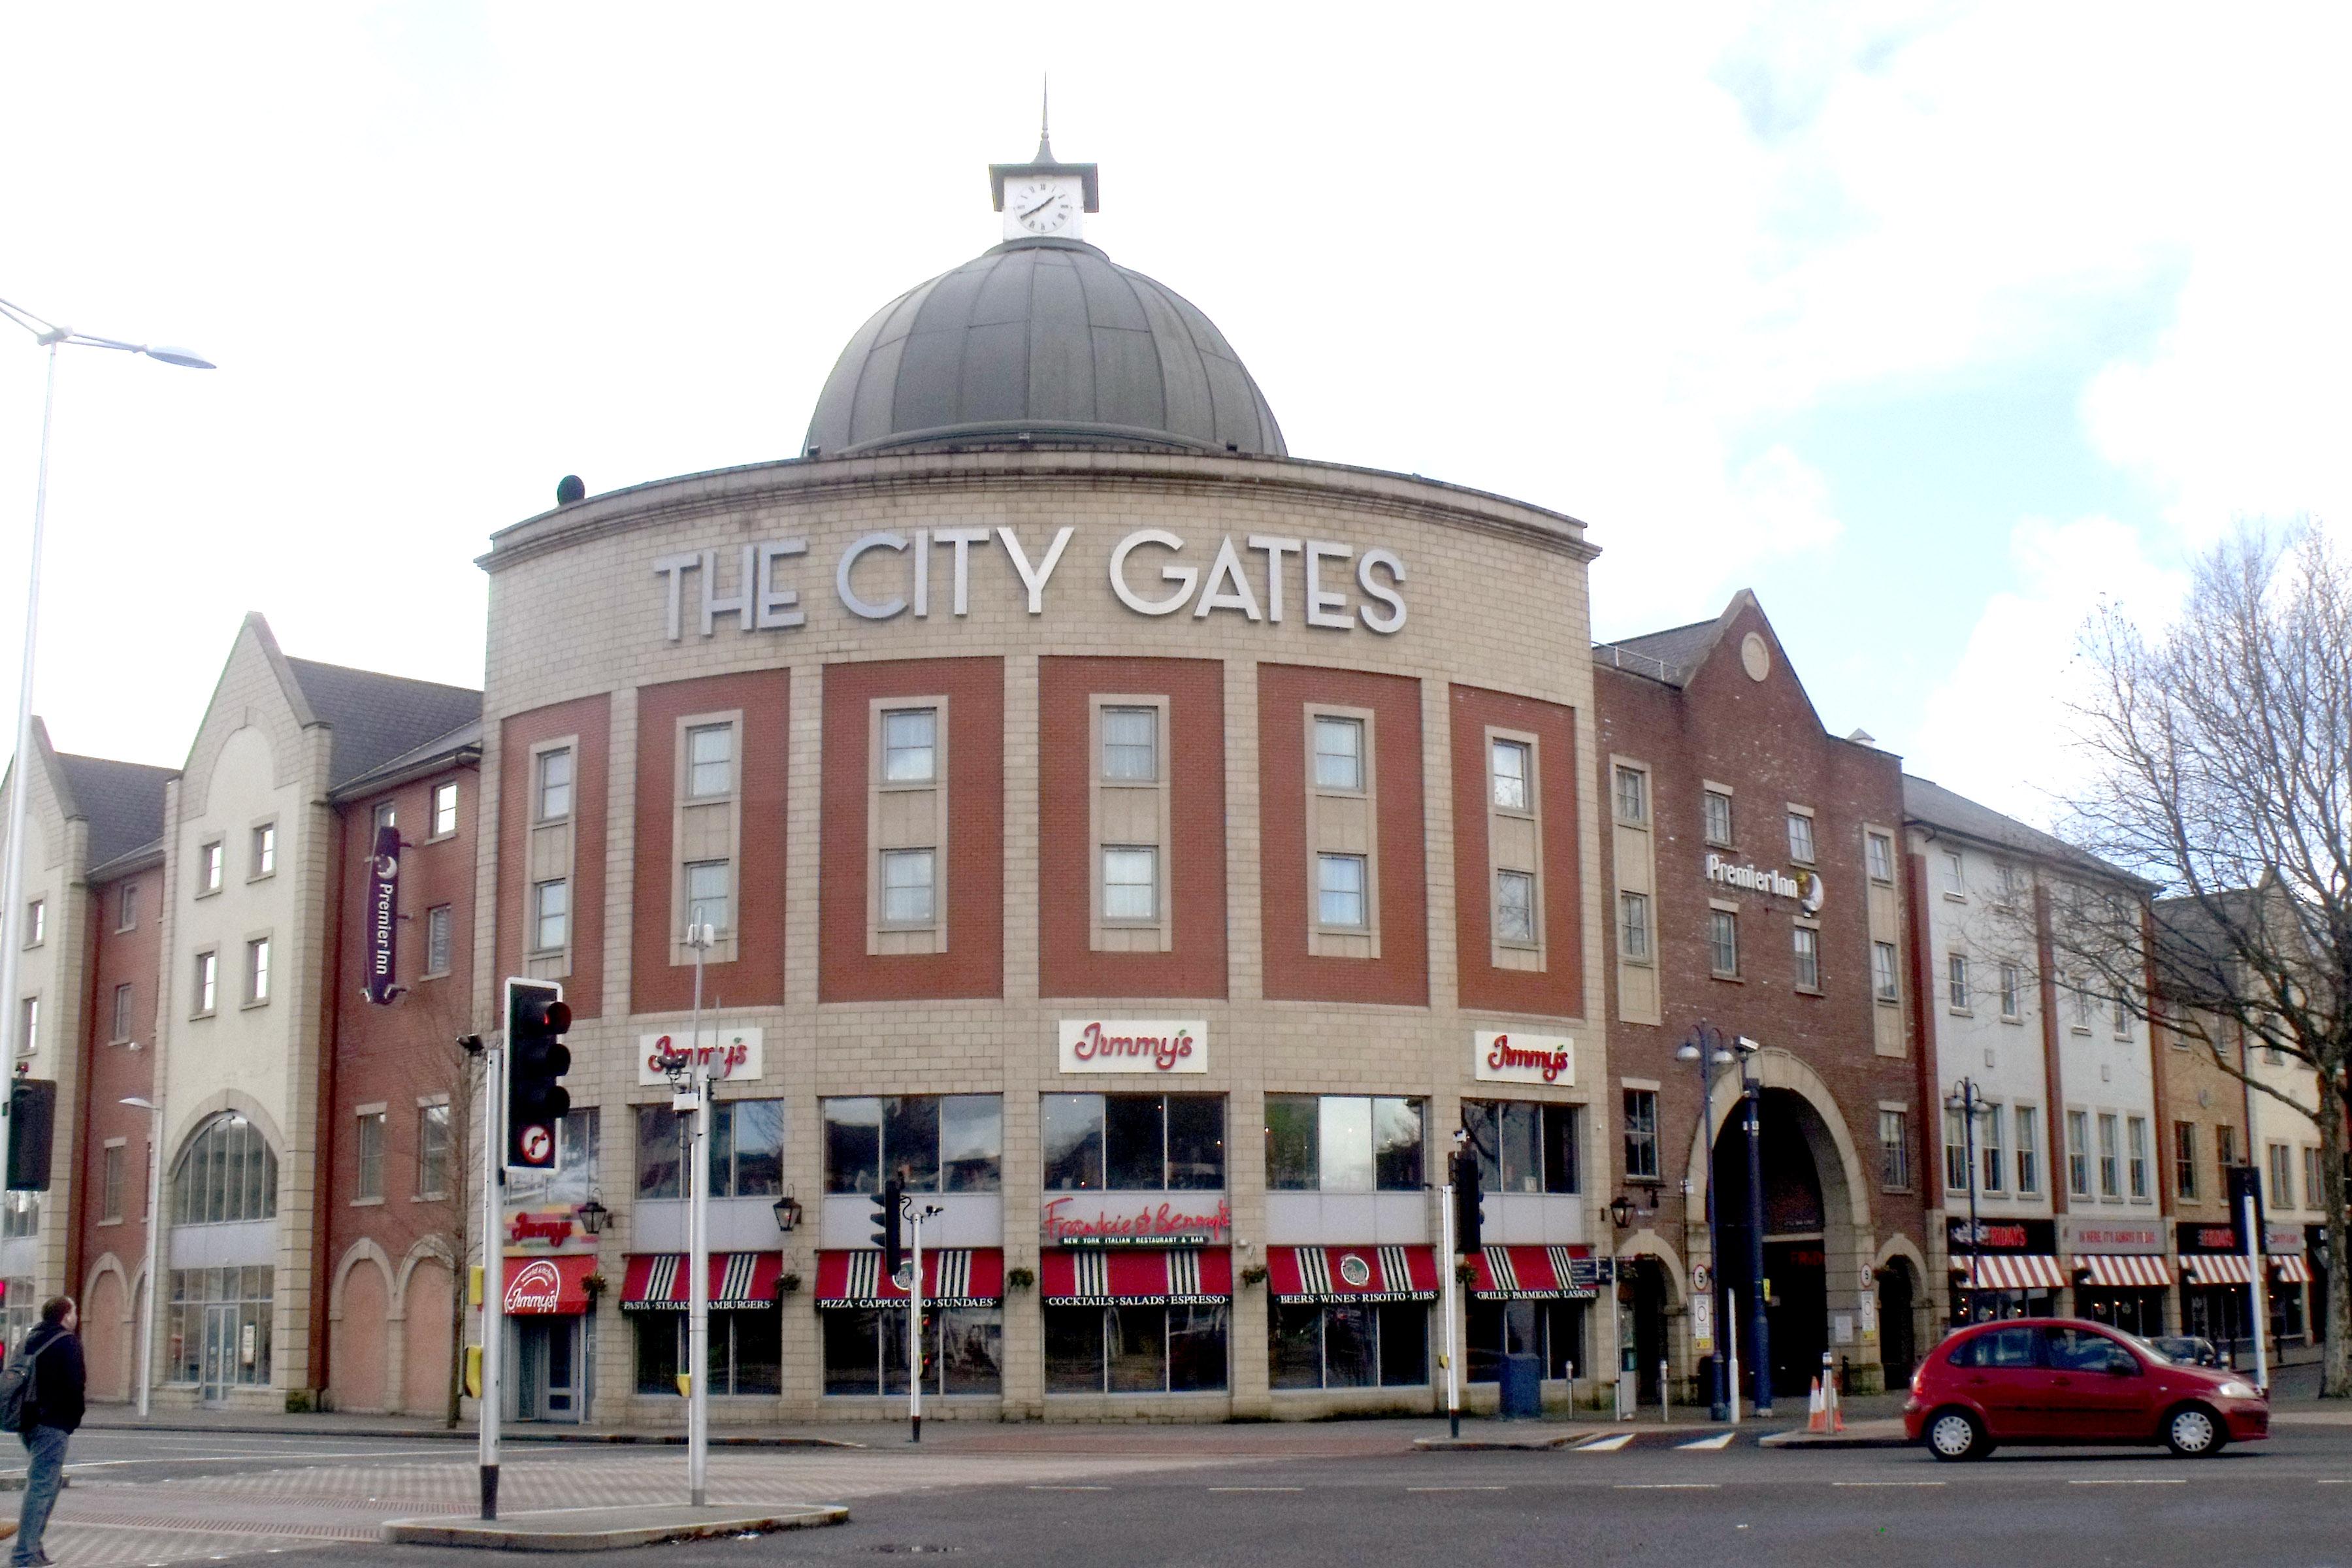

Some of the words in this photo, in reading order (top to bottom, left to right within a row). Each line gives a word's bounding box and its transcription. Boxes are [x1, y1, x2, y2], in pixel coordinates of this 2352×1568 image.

[655, 540, 809, 641] THE
[837, 526, 1075, 619] CITY
[1109, 528, 1408, 634] GATES
[1706, 854, 1771, 892] Premier
[1771, 870, 1798, 898] Inn
[377, 883, 393, 947] Premier
[376, 950, 391, 975] Inn
[1075, 1022, 1193, 1071] Jimmy's
[1488, 1035, 1568, 1082] Jimmy's
[1044, 1197, 1132, 1239] Frankie
[507, 1287, 557, 1313] Jimmy's
[624, 1301, 651, 1310] PASTA
[707, 1300, 771, 1310] AMBURGERS
[821, 1299, 853, 1308] PIZZA
[937, 1298, 993, 1307] SUNDAES
[1049, 1296, 1115, 1305] COCKTAILS
[1119, 1296, 1165, 1305] SALADS
[1170, 1296, 1226, 1305] ESPRESSO
[1280, 1295, 1315, 1303] BEERS
[1320, 1294, 1356, 1303] WINES
[1362, 1292, 1406, 1302] RISOTTO
[1411, 1291, 1435, 1300] RIBS
[1477, 1291, 1509, 1299] GRILLS
[1563, 1290, 1596, 1298] LASAGNE
